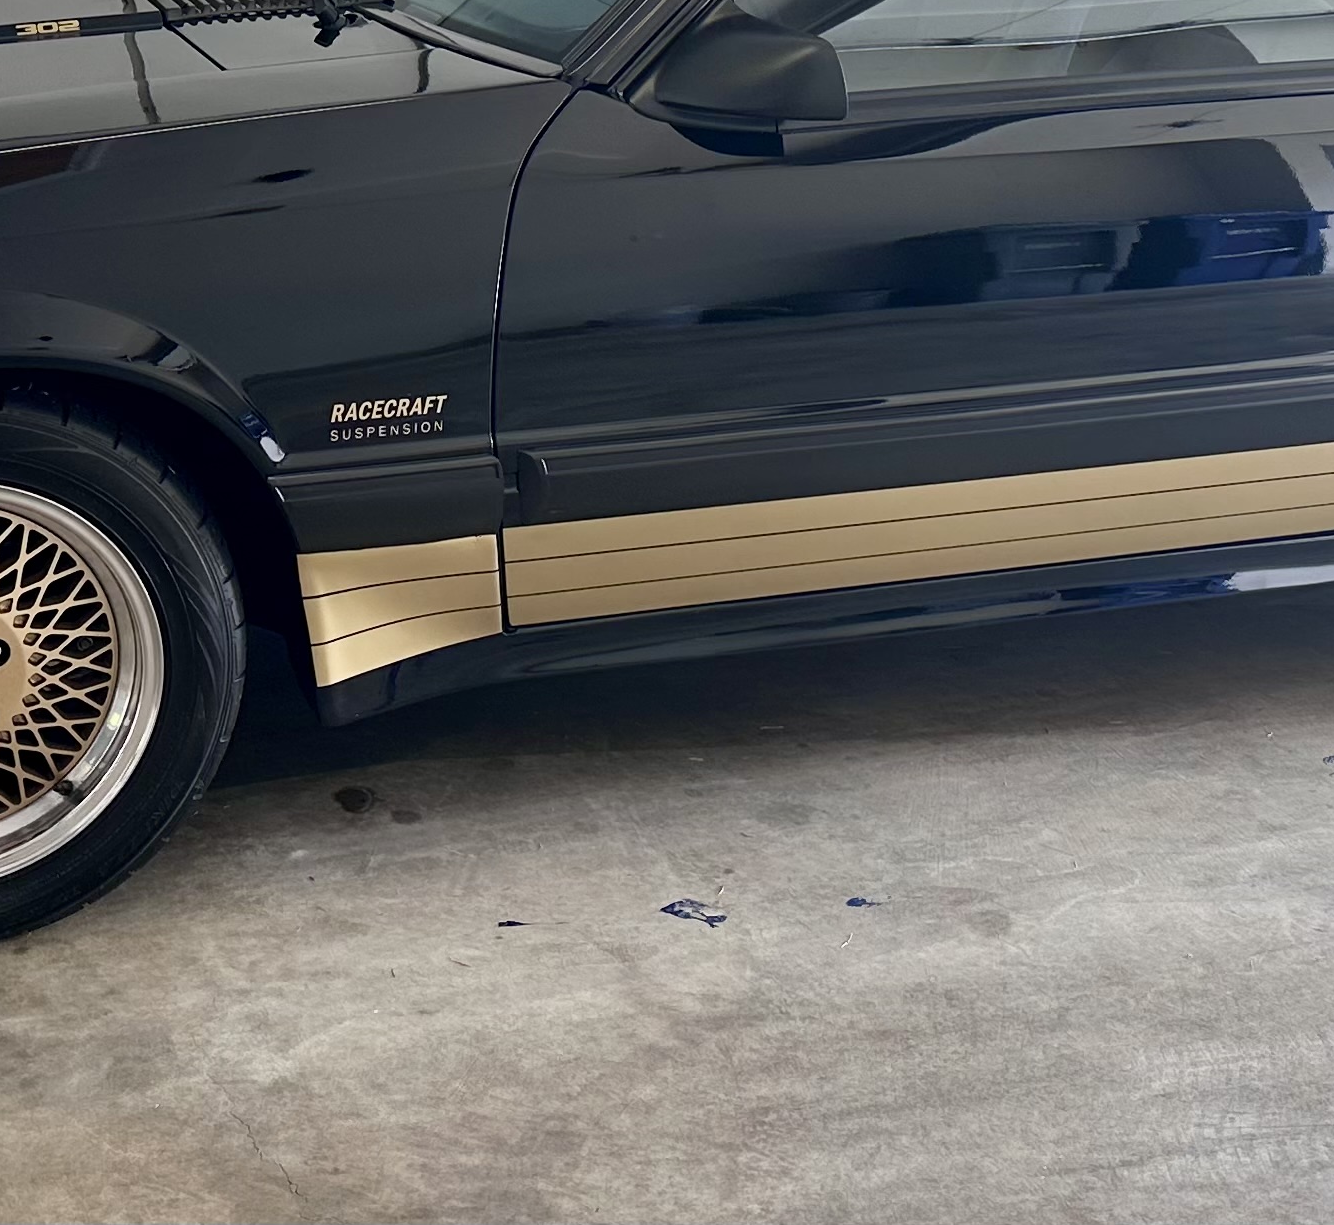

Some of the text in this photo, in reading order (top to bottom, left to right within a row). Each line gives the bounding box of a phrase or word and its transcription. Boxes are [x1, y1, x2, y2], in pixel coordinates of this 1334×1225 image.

[14, 19, 81, 36] 302
[330, 394, 448, 423] RACECRAFT
[330, 420, 444, 442] SUSPENSION
